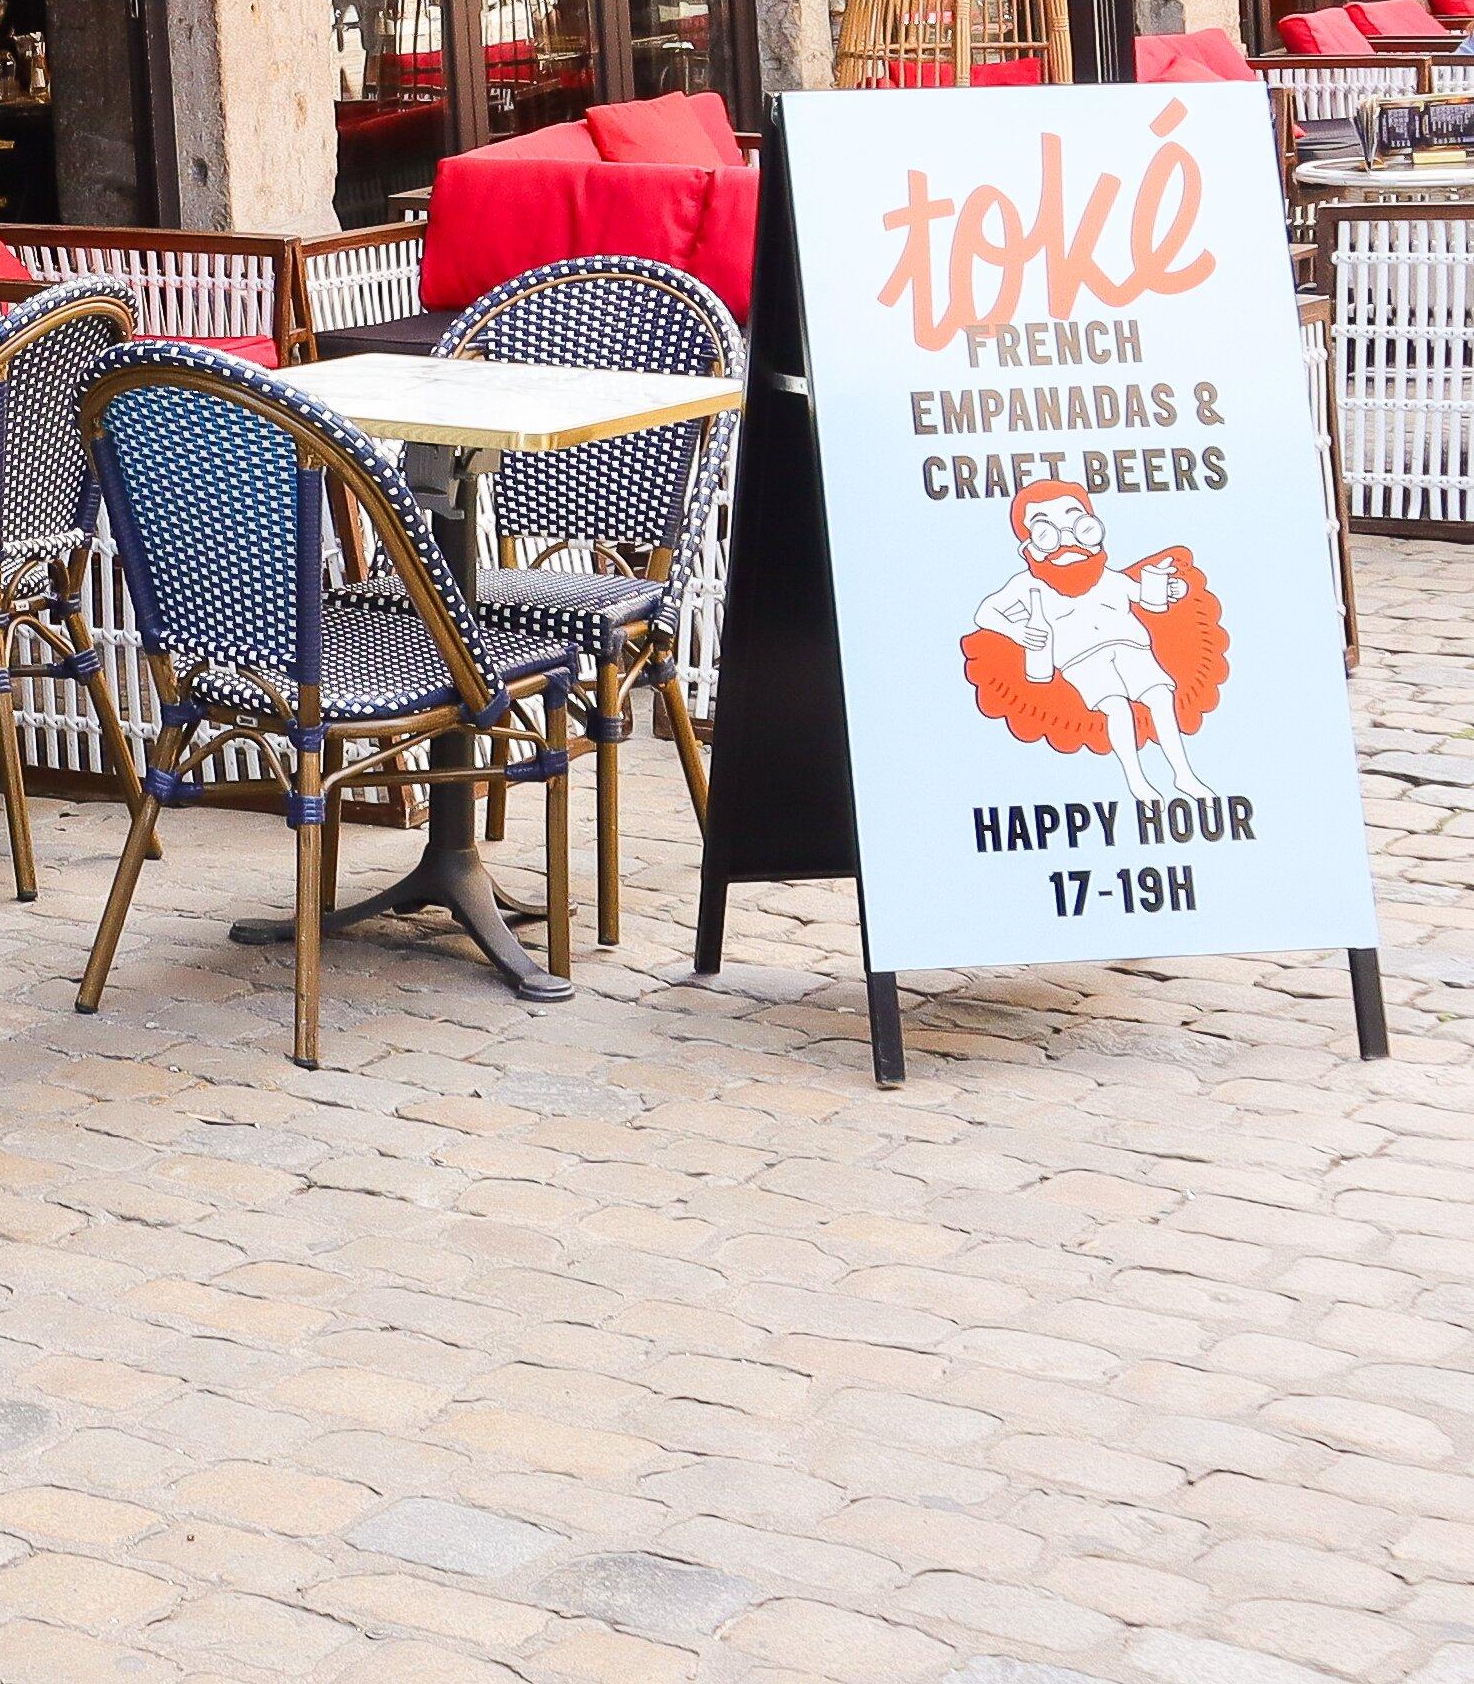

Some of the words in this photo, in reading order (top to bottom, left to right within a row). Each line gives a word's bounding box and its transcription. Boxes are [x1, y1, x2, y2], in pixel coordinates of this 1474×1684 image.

[877, 97, 1216, 351] toké
[965, 319, 1143, 369] FRENCH
[910, 386, 1178, 436] EMPANADAS
[1194, 381, 1226, 426] &
[922, 451, 1067, 501] CRAFT
[1083, 446, 1229, 496] BEERS
[973, 801, 1118, 853] HAPPY
[1139, 795, 1257, 846] HOUR
[1050, 865, 1198, 917] 17-19H
